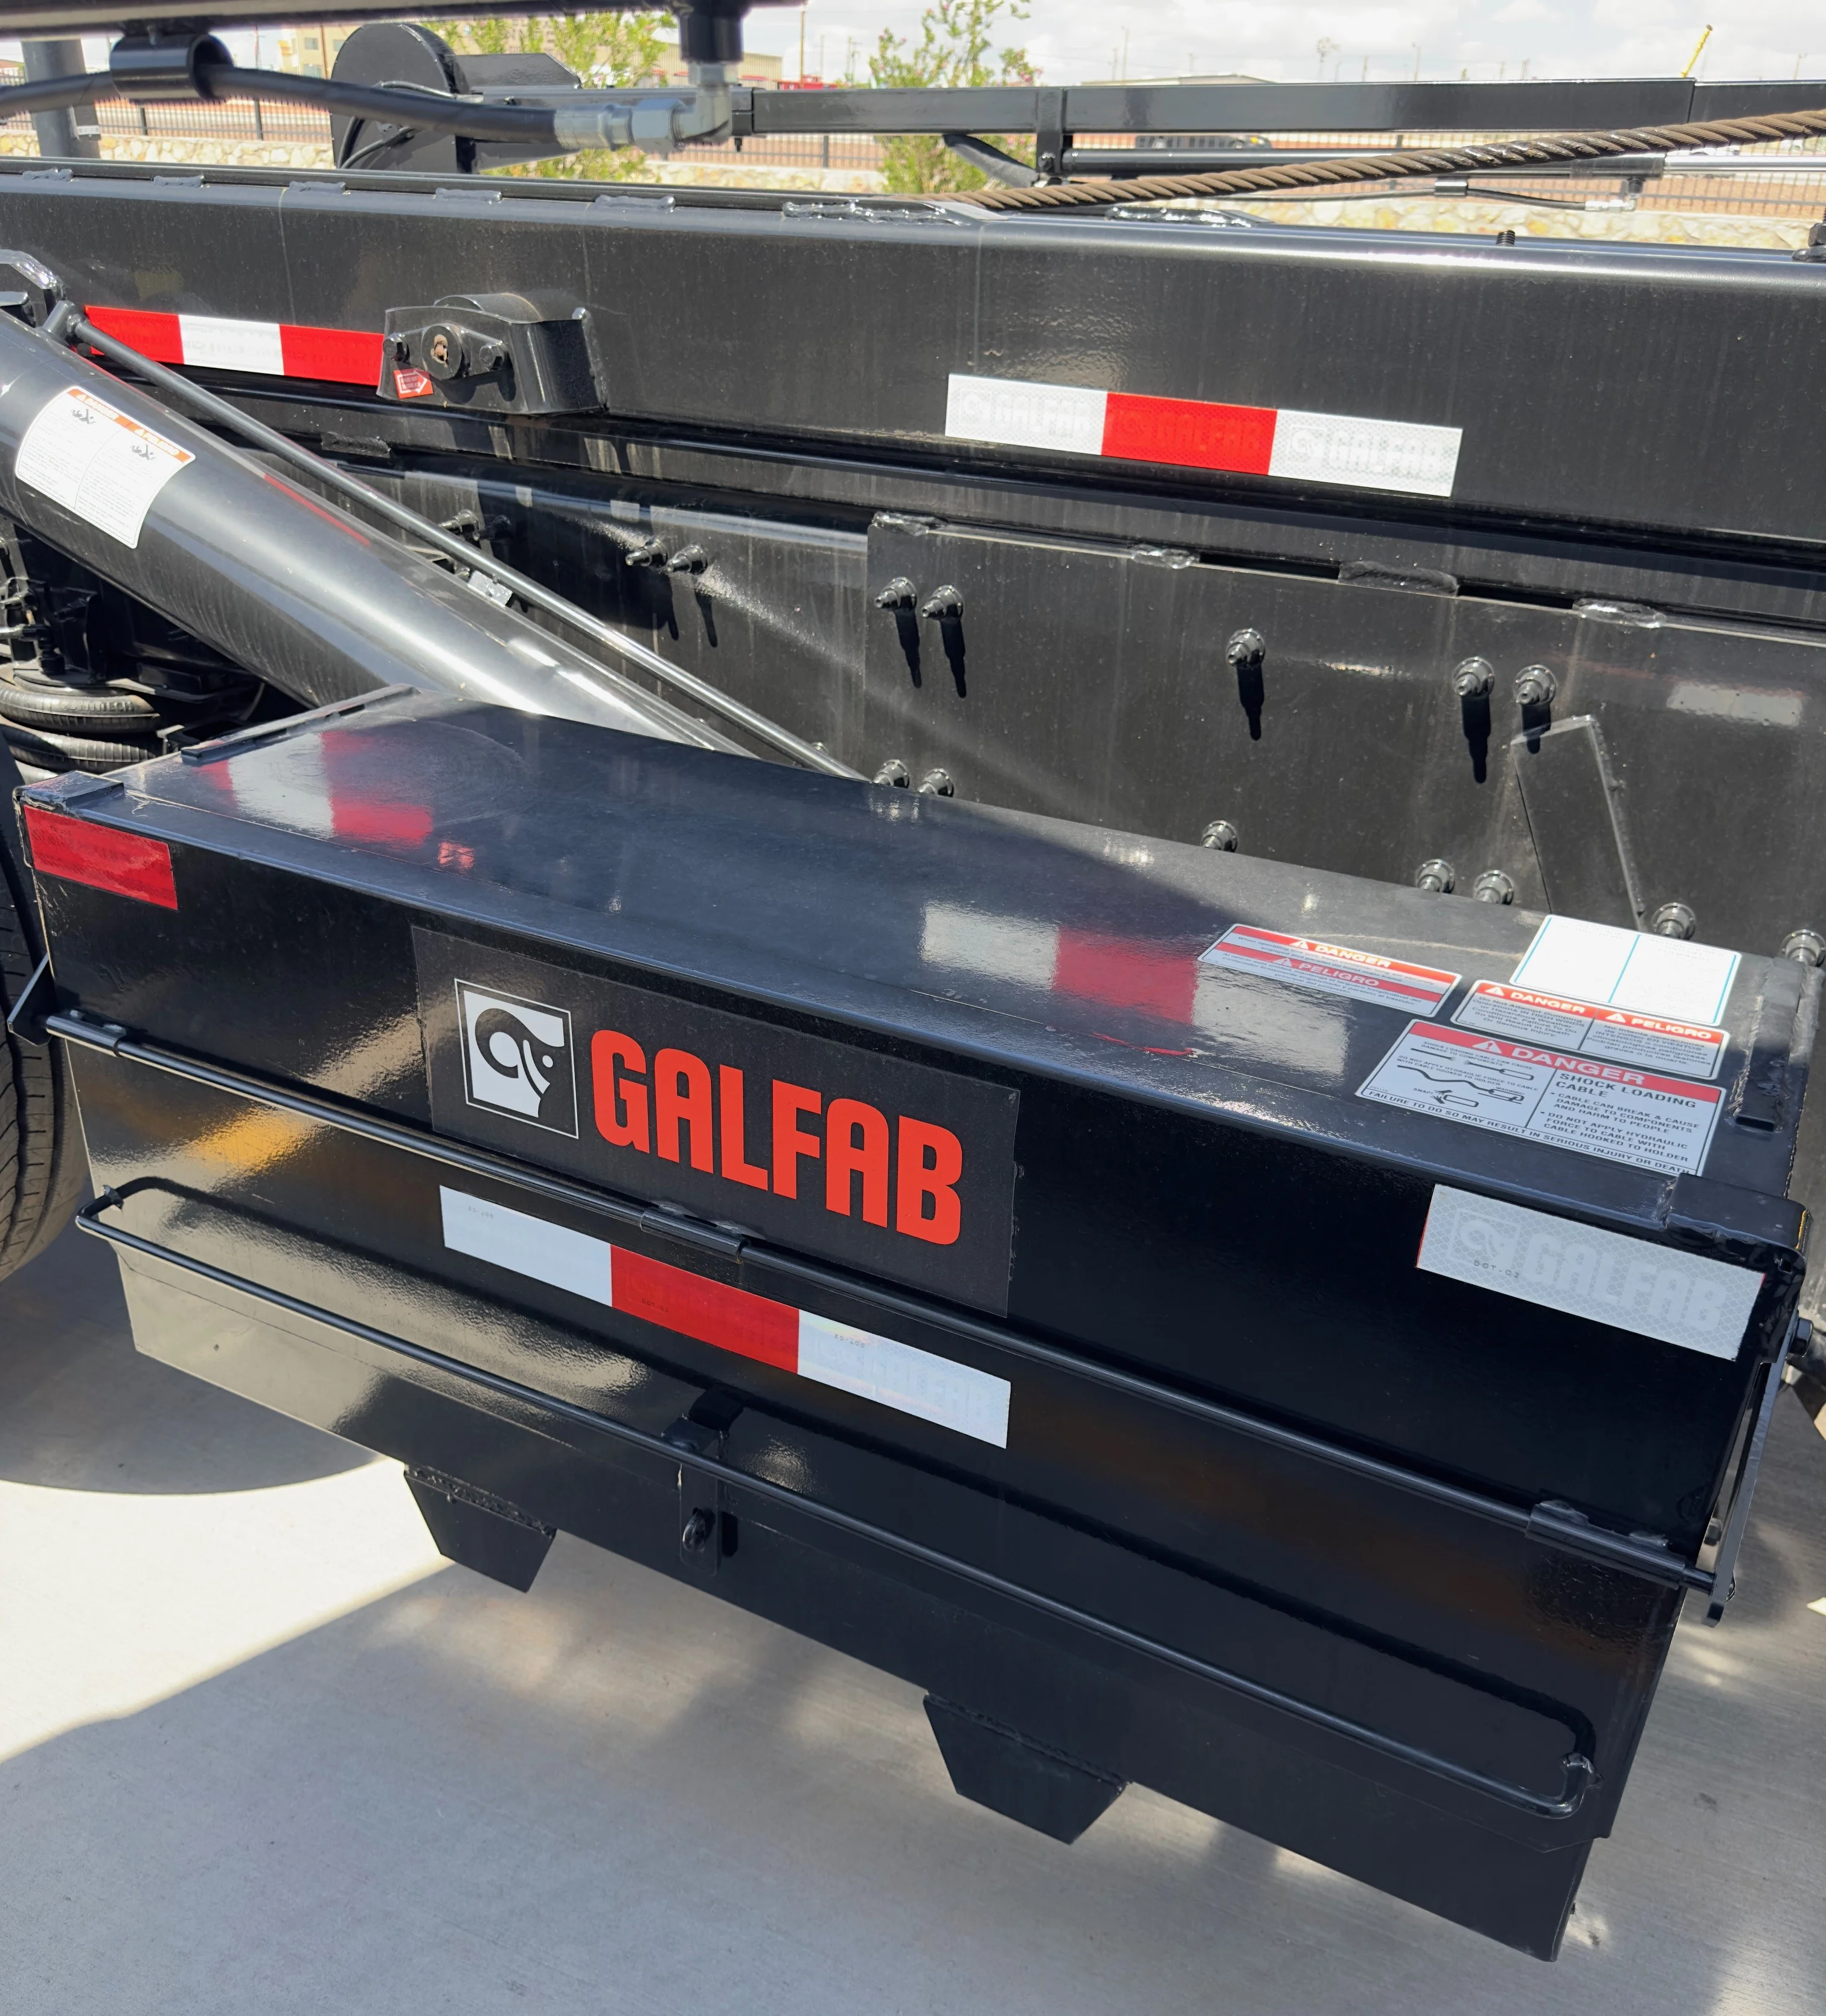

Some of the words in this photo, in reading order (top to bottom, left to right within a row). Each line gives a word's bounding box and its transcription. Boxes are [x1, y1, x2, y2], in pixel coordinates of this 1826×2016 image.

[1312, 944, 1393, 968] DANGER
[1296, 961, 1381, 987] PELIGRO
[1471, 999, 1519, 1012] Operations
[1555, 1018, 1585, 1027] WINDS
[1508, 991, 1587, 1014] DANGER
[1508, 1003, 1542, 1014] Attempt
[1543, 1011, 1583, 1023] Dumping
[1490, 1007, 1536, 1020] Hazardous
[1537, 1018, 1572, 1028] Weather
[1495, 1020, 1528, 1030] Serious
[1504, 1018, 1533, 1027] Result
[1543, 1027, 1570, 1036] Death
[1520, 1018, 1551, 1027] Failure
[1630, 1016, 1712, 1041] PELIGRO
[1420, 1044, 1448, 1053] DAMAGE
[1458, 1053, 1504, 1067] COMPONENTS
[1444, 1046, 1475, 1056] LOADING
[1434, 1067, 1462, 1077] HOOKED
[1473, 1077, 1501, 1086] HOLDER
[1443, 1066, 1482, 1078] HYDRAULIC
[1510, 1047, 1647, 1086] DANGER
[1554, 1080, 1609, 1098] CABLE
[1558, 1072, 1616, 1091] SHOCK
[1620, 1085, 1697, 1109] LOADING
[1552, 1102, 1576, 1112] AND
[1577, 1108, 1610, 1120] HARM
[1629, 1120, 1670, 1134] PEOPLE
[1555, 1097, 1600, 1112] DAMAGE
[1619, 1112, 1693, 1134] COMPONENTS
[1557, 1092, 1591, 1104] CABLE
[1592, 1100, 1615, 1109] CAN
[1616, 1106, 1652, 1118] BREAK
[1664, 1117, 1700, 1129] CAUSE
[591, 1029, 963, 1245] GALFAB
[1368, 1091, 1411, 1105] FAILURE
[1460, 1114, 1485, 1123] MAY
[1485, 1120, 1527, 1134] RESULT
[1542, 1134, 1591, 1150] SERIOUS
[1592, 1146, 1633, 1161] INJURY
[1635, 1157, 1652, 1166] OR
[1545, 1117, 1581, 1130] FORCE
[1600, 1130, 1635, 1143] CABLE
[1636, 1139, 1667, 1151] WITH
[1565, 1116, 1587, 1125] NOT
[1589, 1122, 1623, 1134] APPLY
[1625, 1130, 1688, 1149] HYDRAULIC
[1542, 1122, 1577, 1135] CABLE
[1578, 1131, 1624, 1146] HOOKED
[1643, 1147, 1689, 1163] HOLDER
[1473, 1260, 1520, 1279] DOT-C2
[1524, 1232, 1728, 1330] GALFAB
[835, 1334, 865, 1349] DOT-C2
